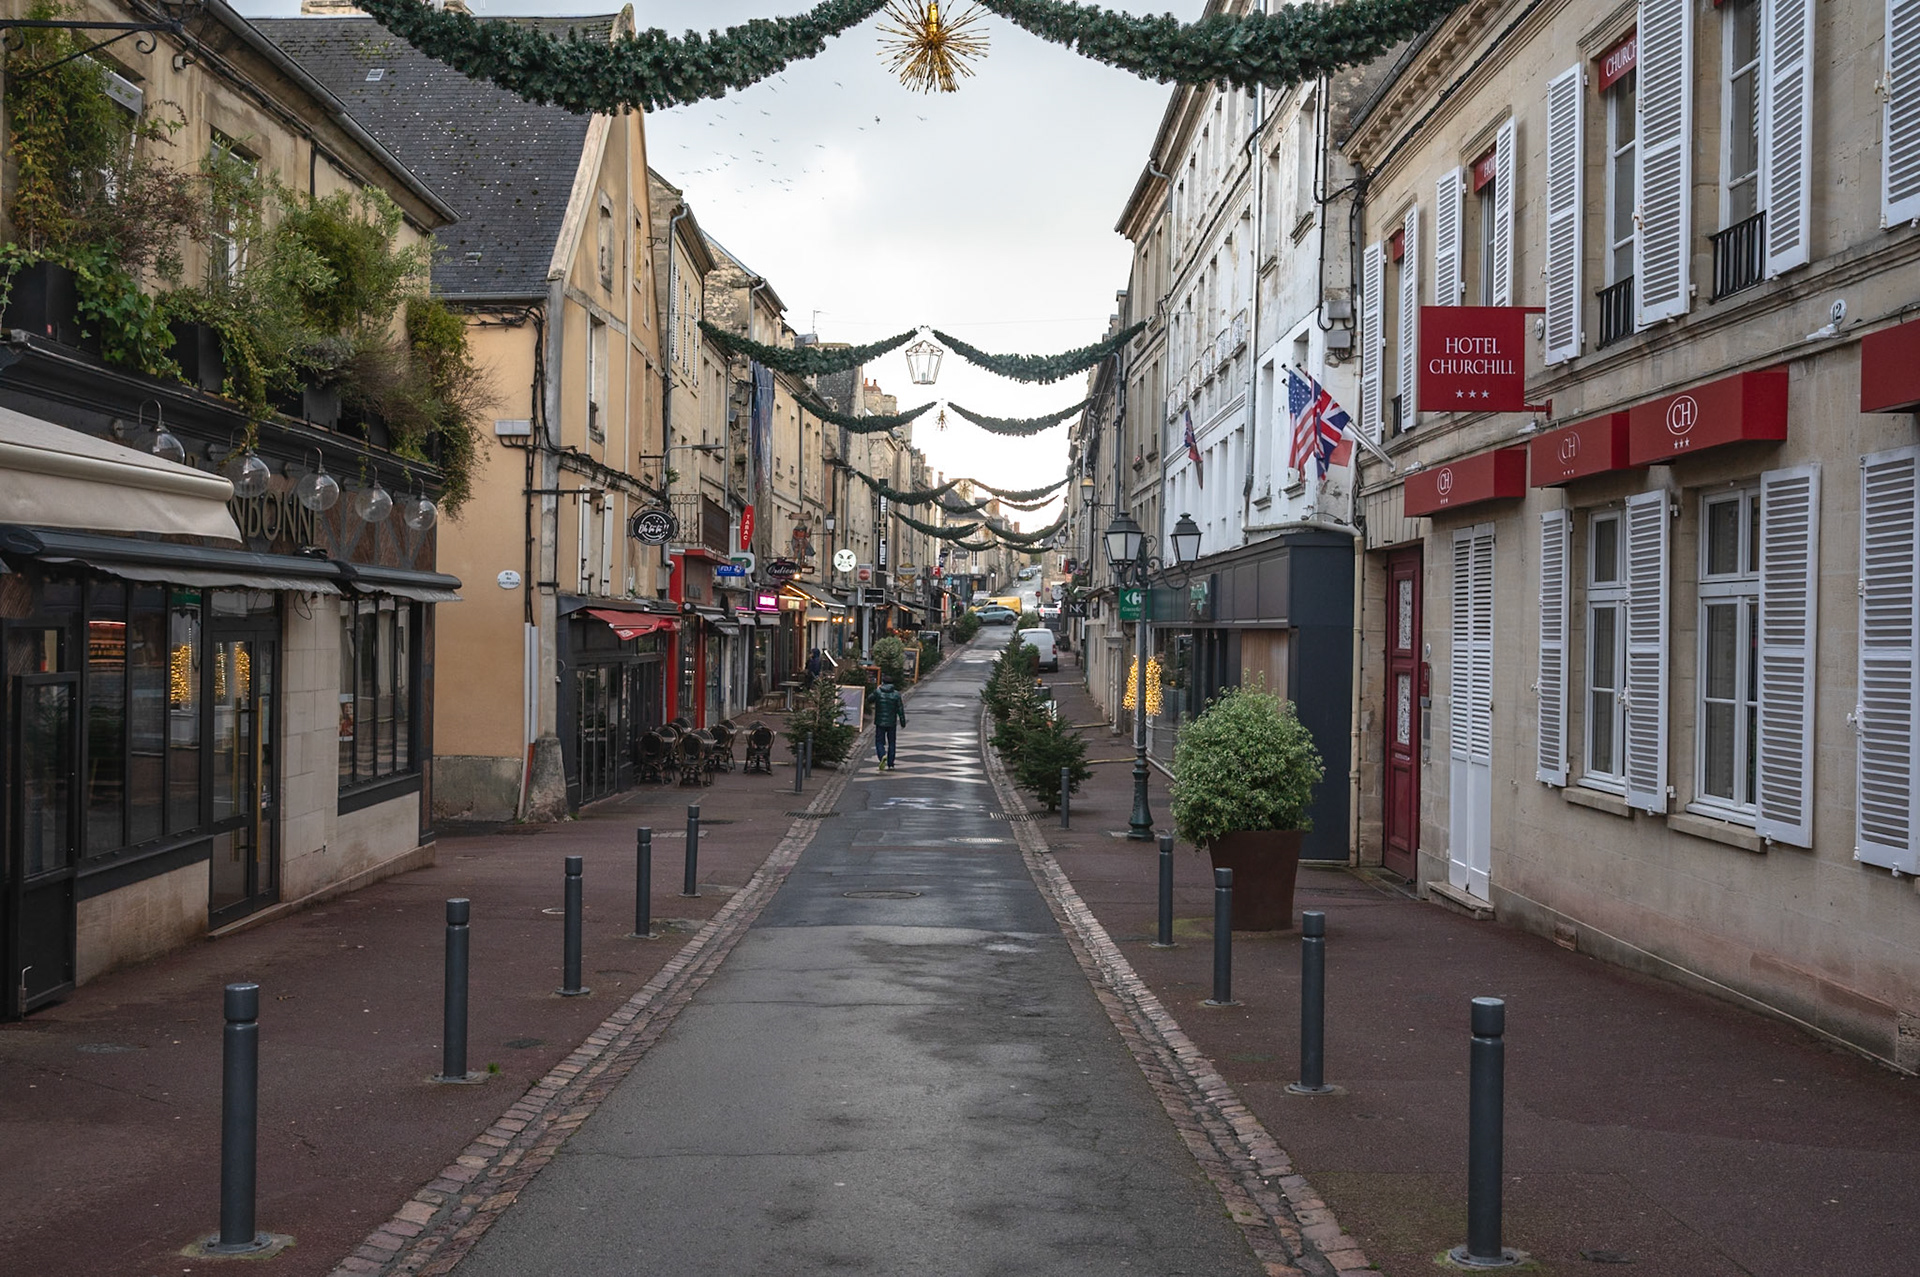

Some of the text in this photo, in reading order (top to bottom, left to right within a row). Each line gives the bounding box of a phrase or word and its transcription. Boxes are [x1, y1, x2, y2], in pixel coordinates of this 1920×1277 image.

[1606, 40, 1637, 77] CHURCH
[1832, 302, 1842, 323] 12
[1445, 336, 1501, 355] HOTEL
[1429, 358, 1516, 375] CHURCHILL
[1672, 401, 1691, 429] CH
[1561, 436, 1576, 459] CH
[1440, 472, 1450, 491] CH
[1069, 603, 1084, 613] NK
